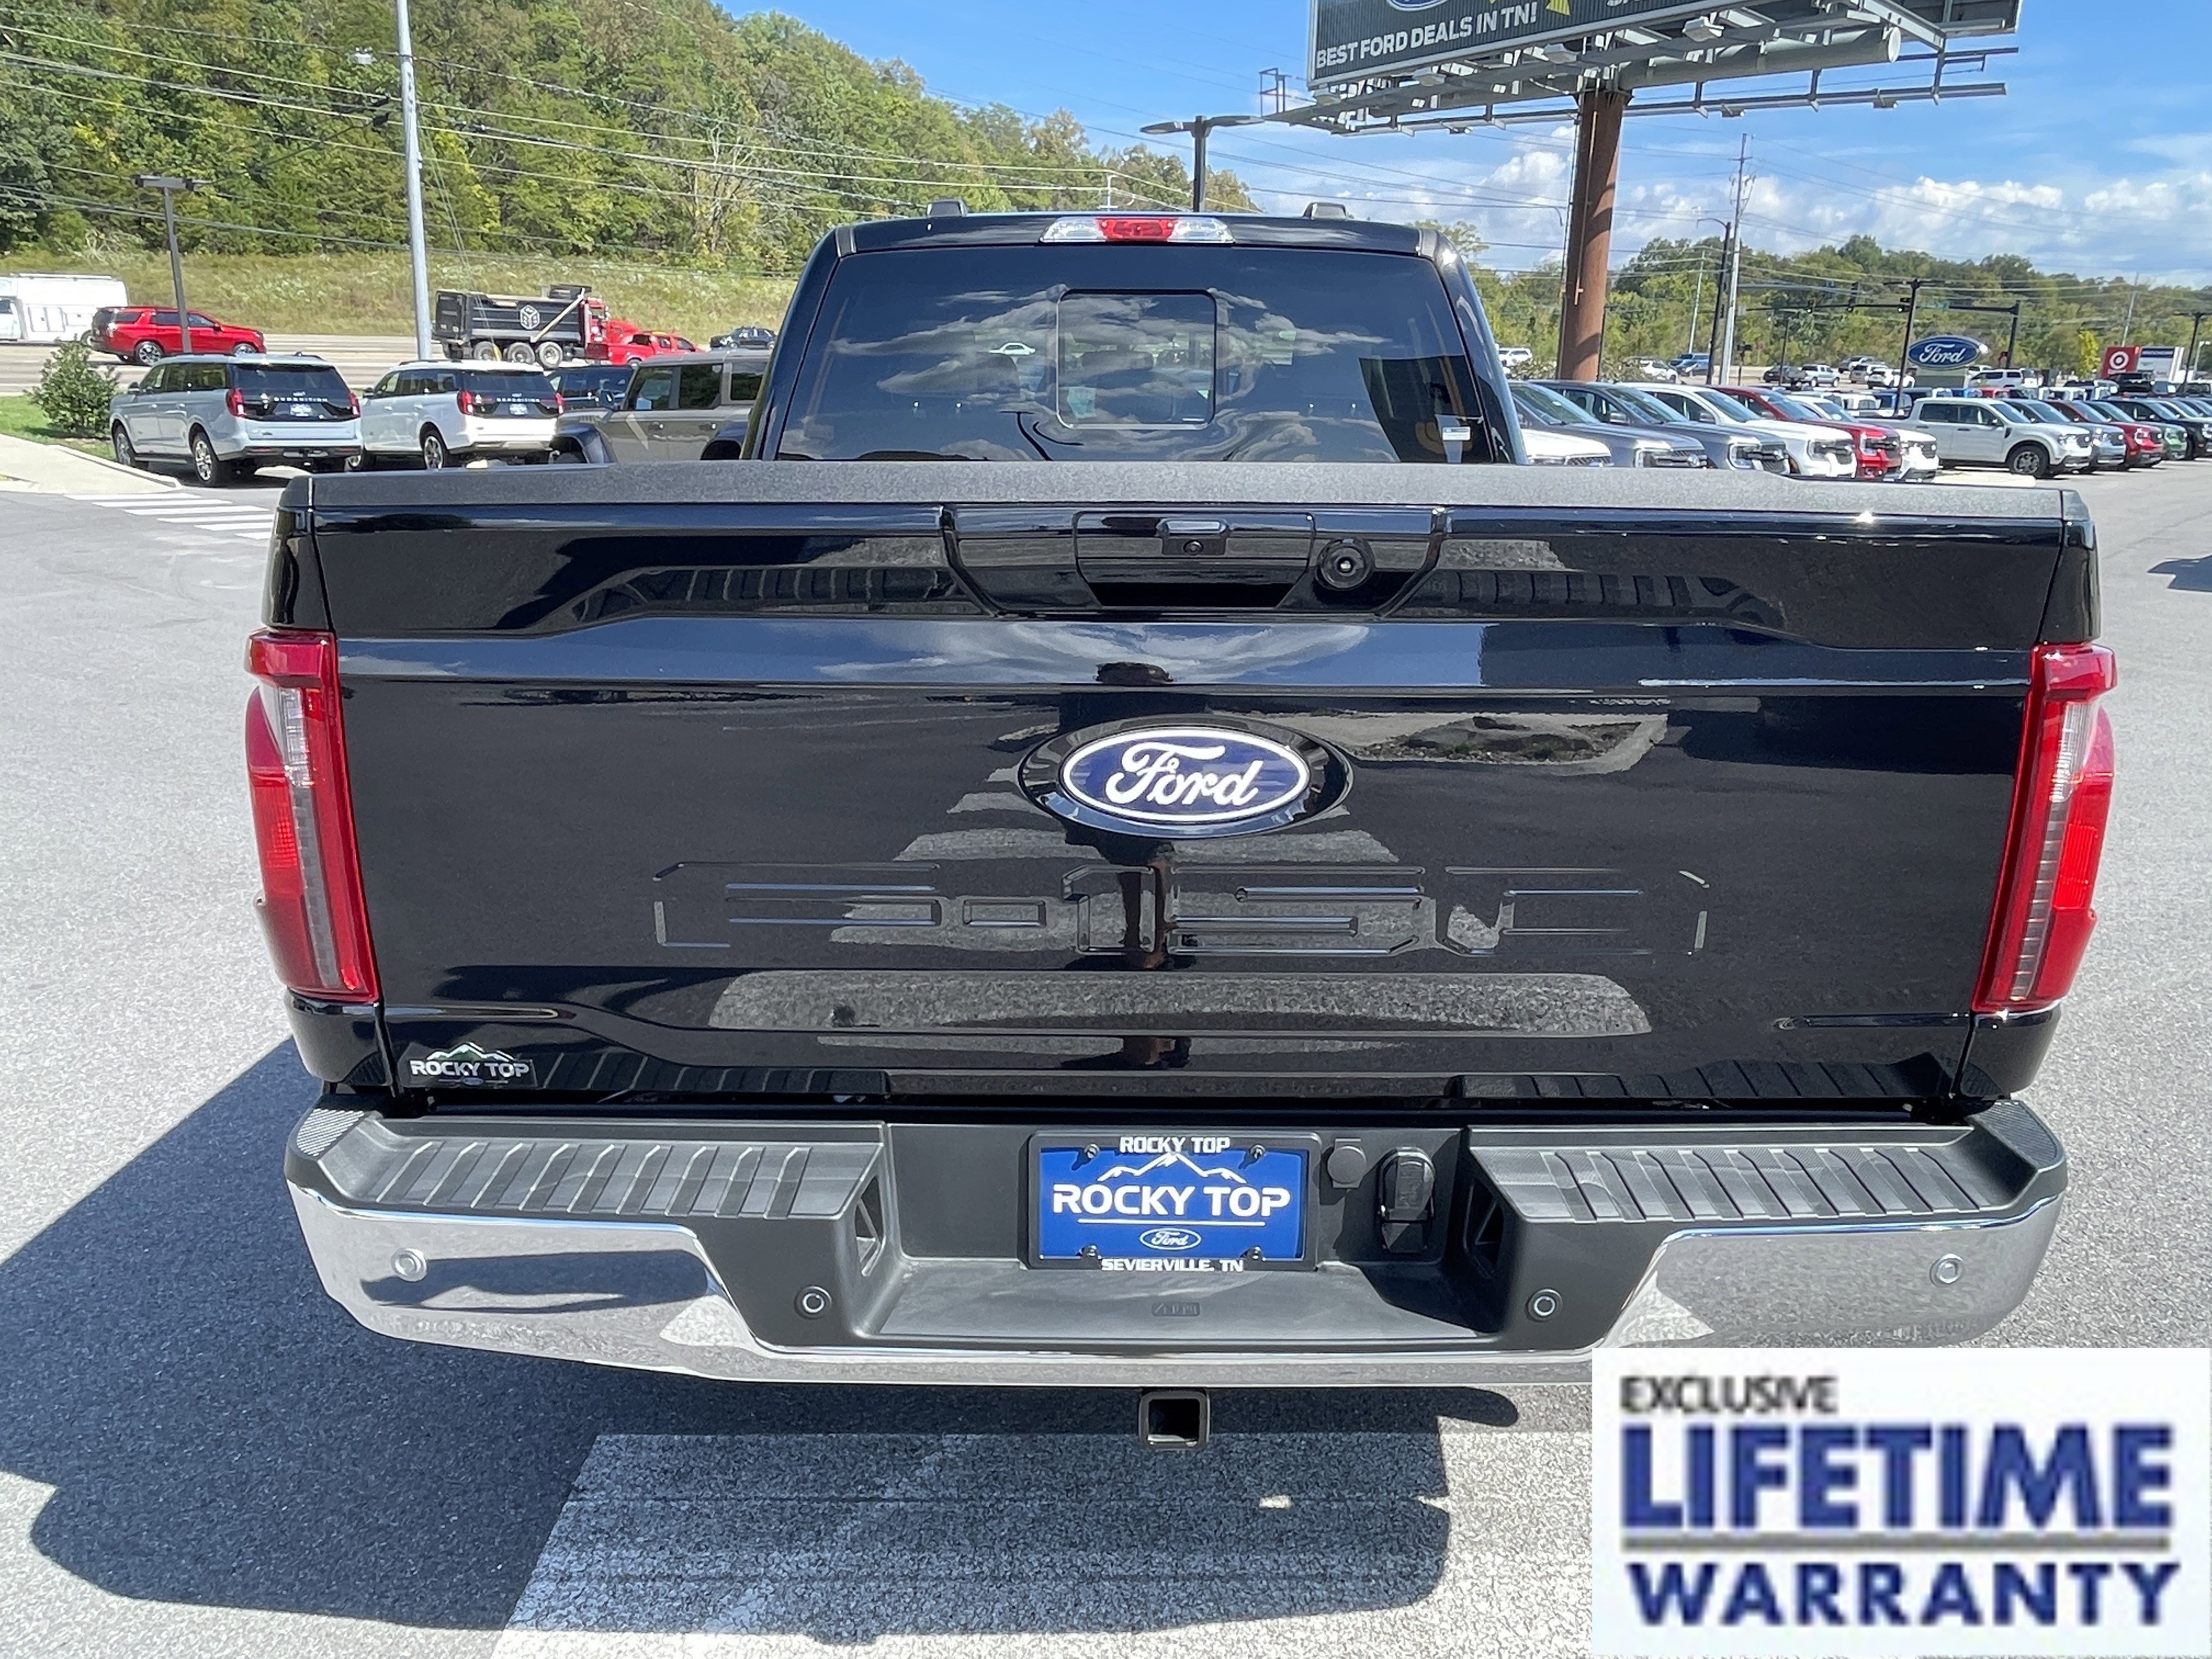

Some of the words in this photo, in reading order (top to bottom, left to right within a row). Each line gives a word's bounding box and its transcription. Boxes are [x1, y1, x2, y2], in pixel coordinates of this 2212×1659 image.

[1317, 43, 1358, 69] BEST
[1360, 31, 1408, 59] FORD
[1410, 16, 1473, 48] DEALS
[1476, 10, 1497, 35] IN
[1500, 2, 1537, 29] TN!
[1919, 343, 1966, 363] Ford
[1105, 742, 1264, 805] Ford
[410, 1060, 481, 1076] ROCKY
[484, 1062, 530, 1077] TOP
[1119, 1137, 1186, 1153] ROCKY
[1191, 1137, 1231, 1153] TOP
[1052, 1184, 1196, 1216] ROCKY
[1203, 1187, 1291, 1217] TOP
[1151, 1231, 1188, 1246] Ford
[1219, 1259, 1244, 1272] TN
